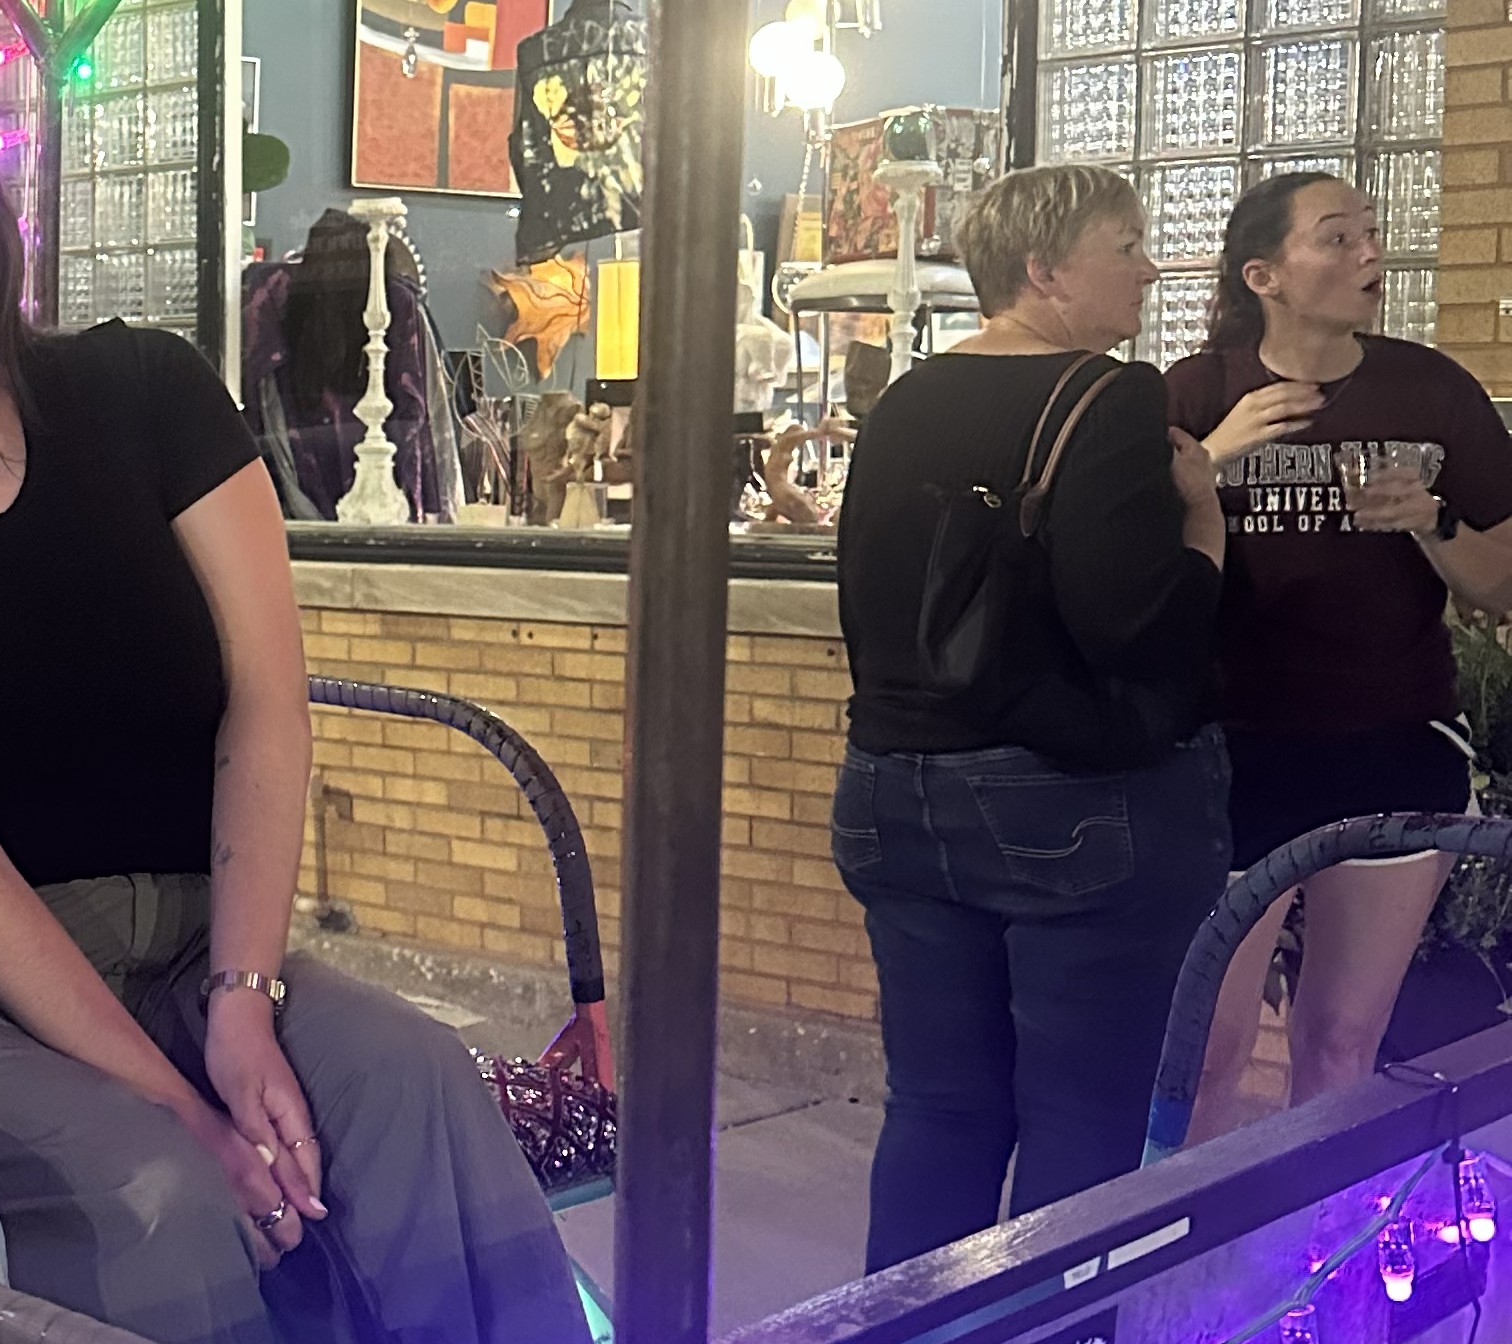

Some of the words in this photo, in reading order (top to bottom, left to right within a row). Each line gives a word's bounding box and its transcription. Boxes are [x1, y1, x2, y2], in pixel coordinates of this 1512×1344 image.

[1217, 443, 1331, 487] UTHERN
[1249, 487, 1349, 513] UNIVER
[1298, 515, 1326, 533] OF
